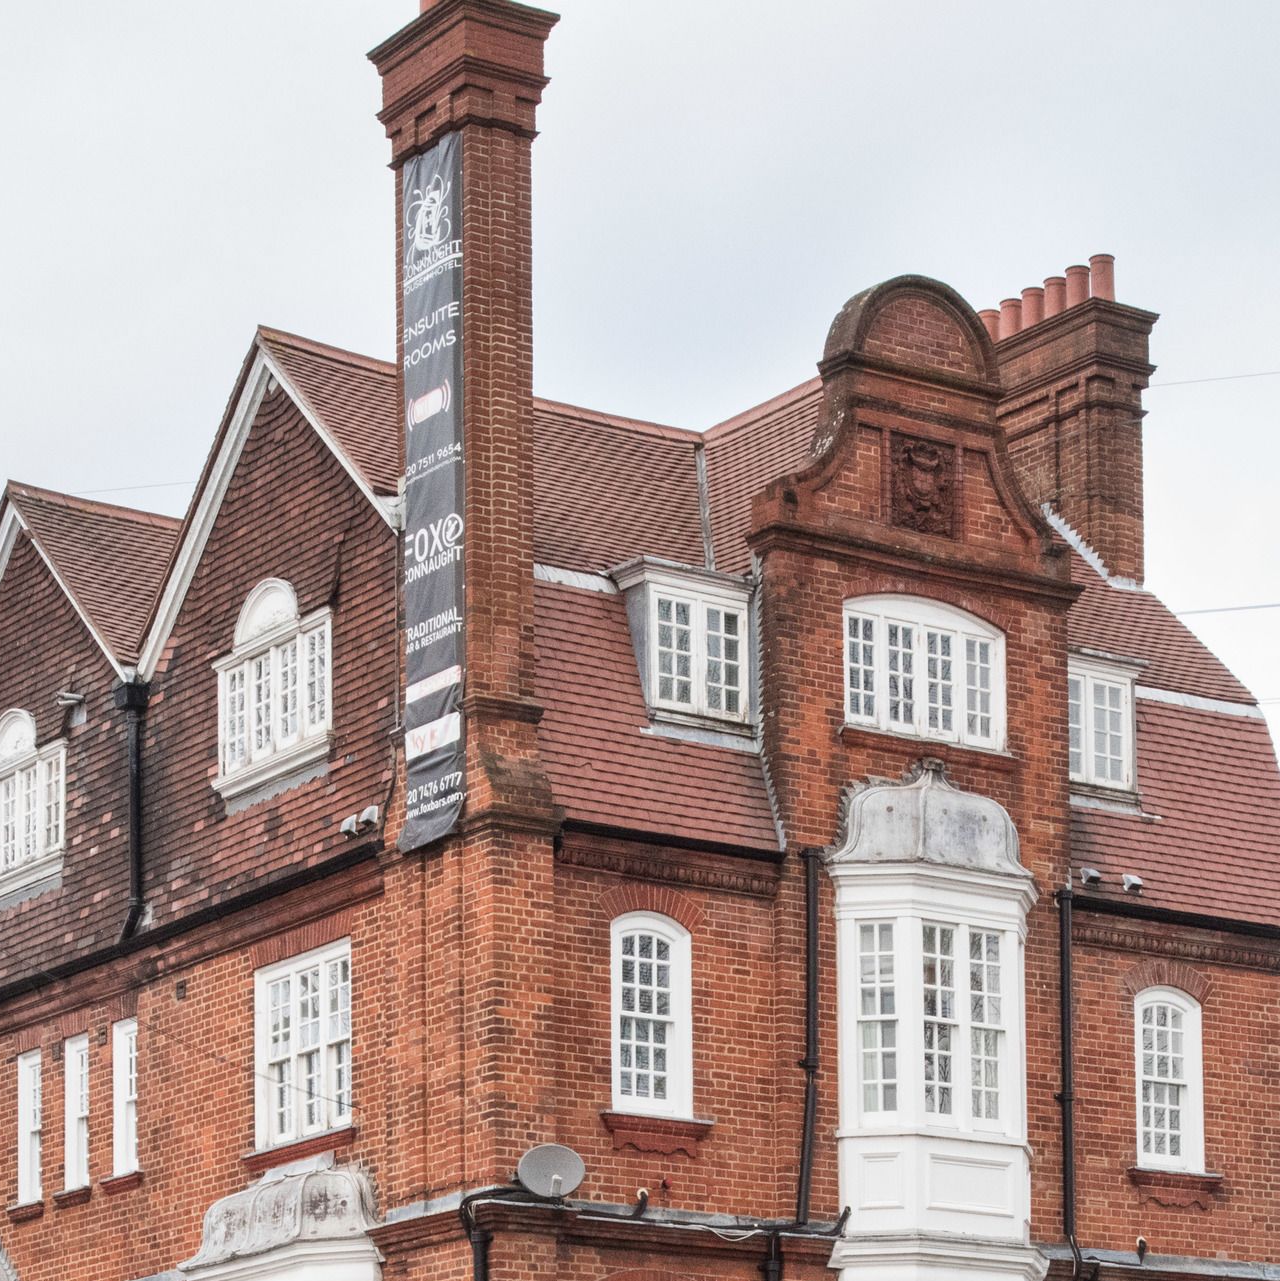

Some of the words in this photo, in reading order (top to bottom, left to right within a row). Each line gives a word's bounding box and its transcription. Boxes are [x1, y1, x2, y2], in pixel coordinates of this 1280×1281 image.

[404, 278, 424, 296] OUSE
[404, 301, 460, 344] ENSUITE
[404, 329, 457, 371] ROOMS
[418, 453, 435, 471] 7511
[436, 442, 462, 460] 9654
[405, 606, 463, 643] RADITIONAL
[421, 622, 463, 648] RESTAURANT
[419, 780, 439, 801] 7476
[440, 771, 463, 792] 6777
